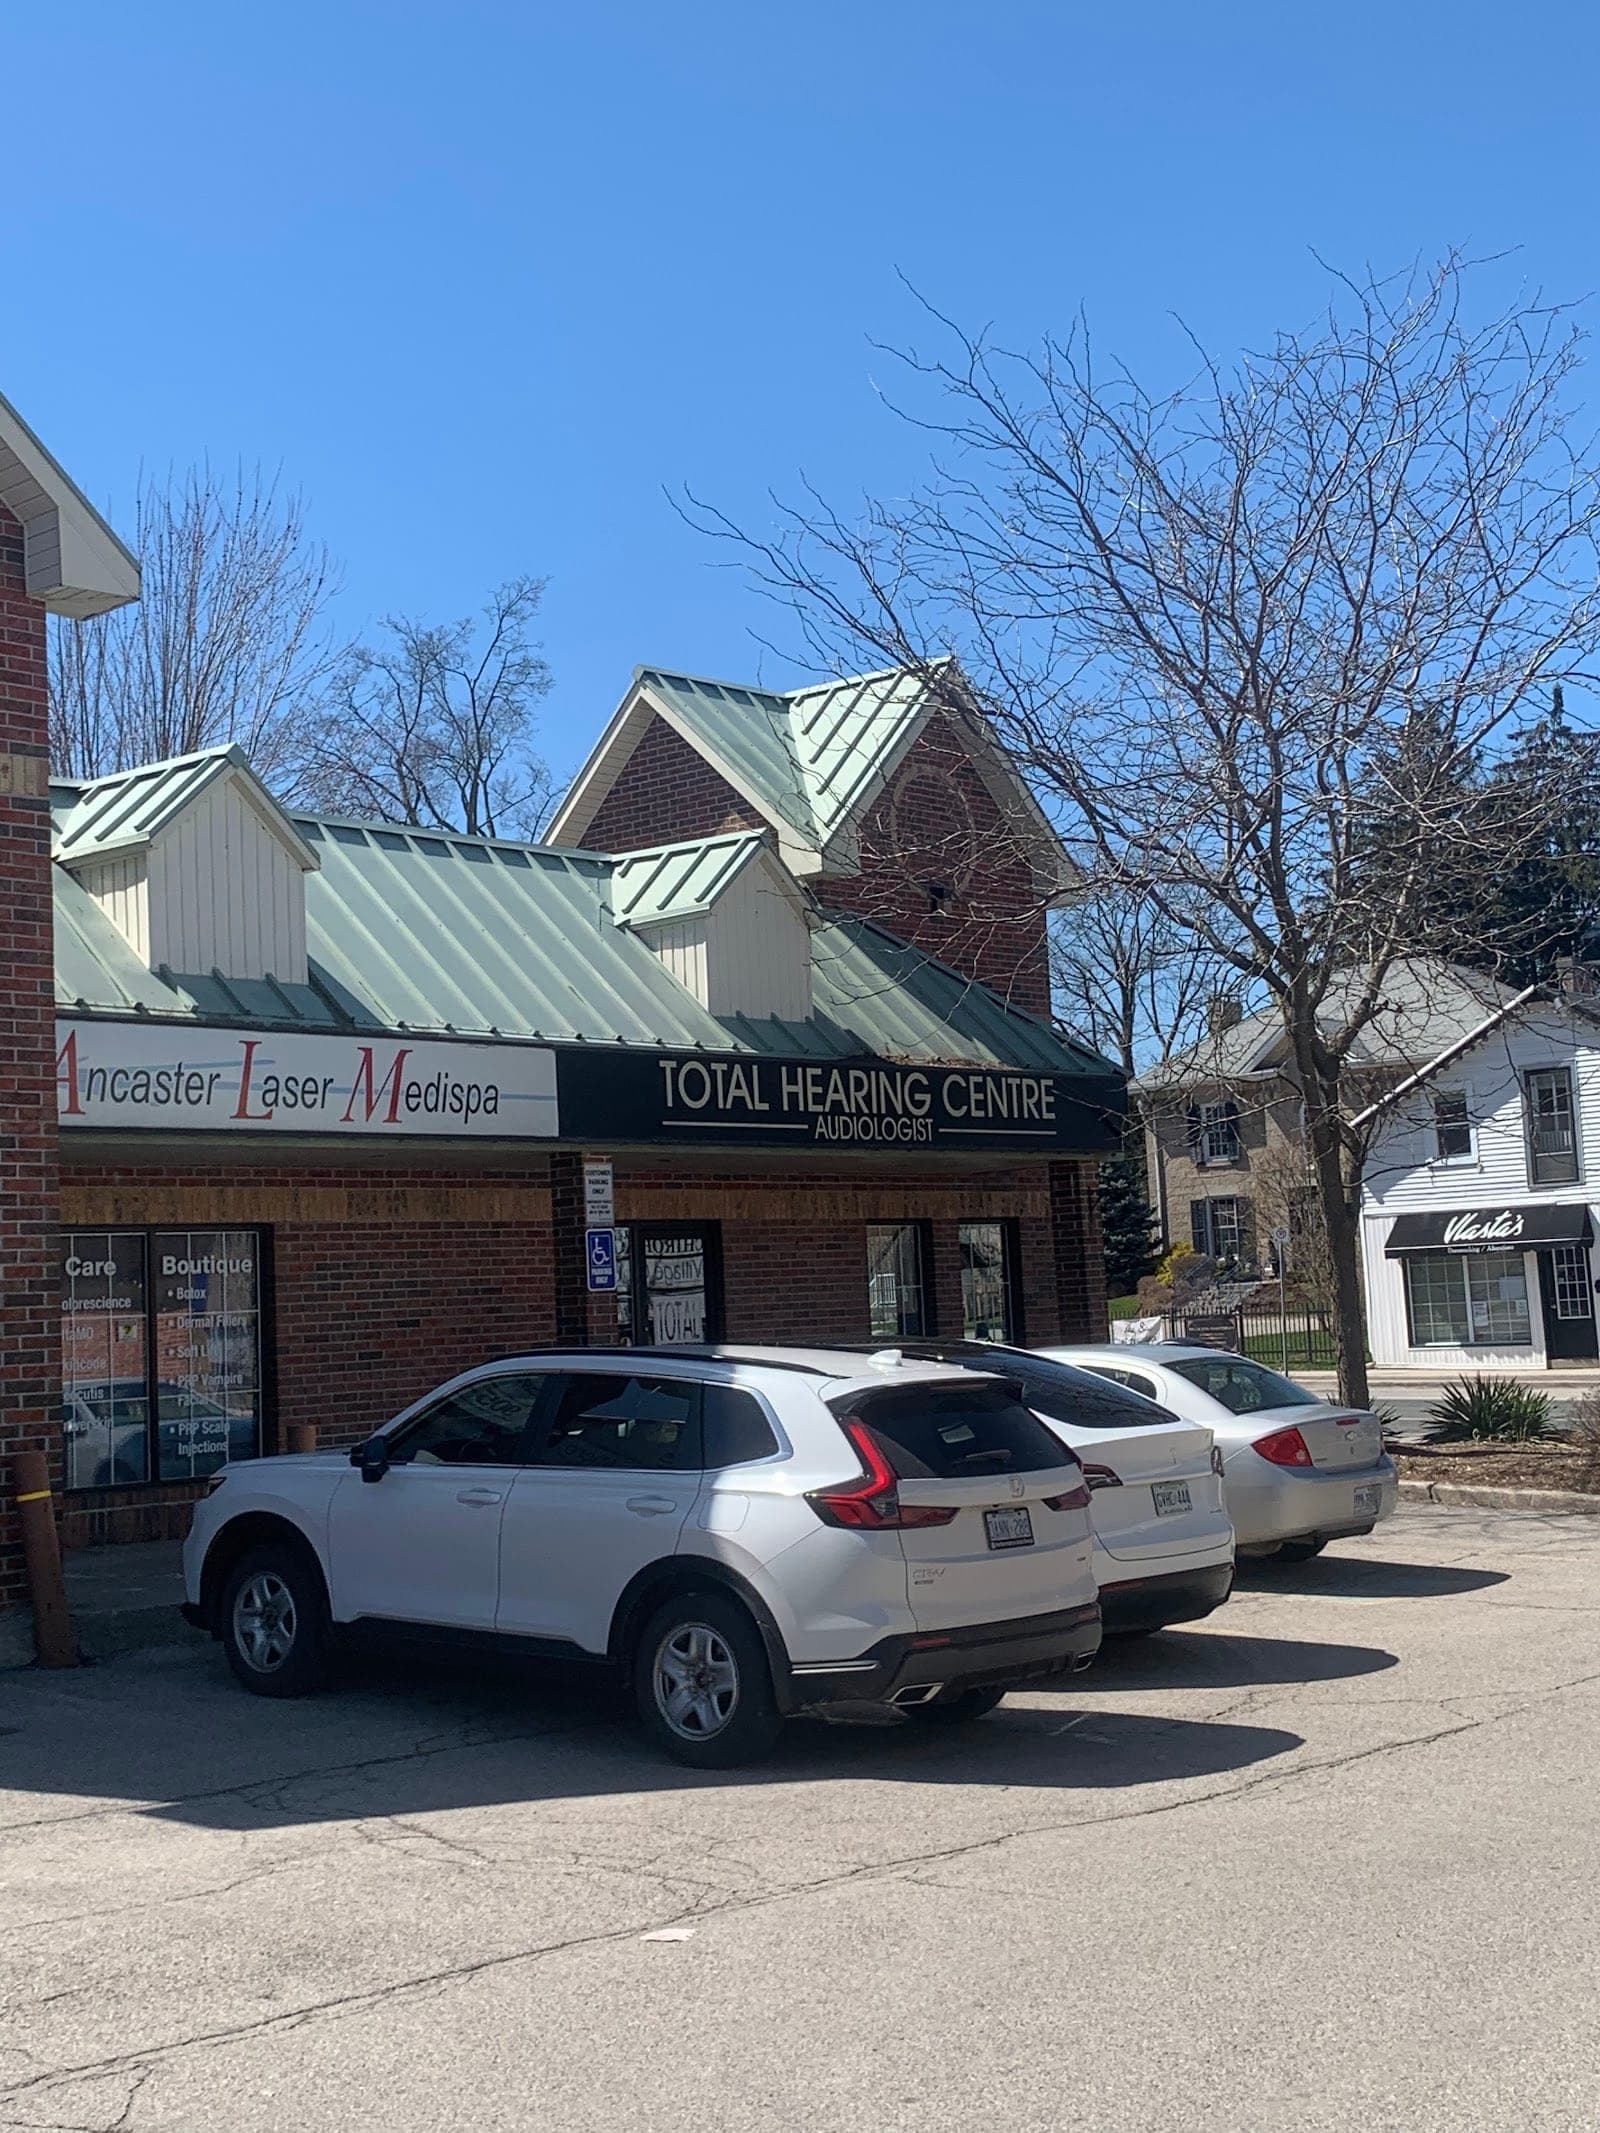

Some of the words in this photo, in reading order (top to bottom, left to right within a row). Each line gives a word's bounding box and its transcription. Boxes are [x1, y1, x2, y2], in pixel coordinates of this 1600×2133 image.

[55, 1029, 221, 1116] Ancaster
[229, 1040, 334, 1121] Laser
[339, 1046, 500, 1124] Medispa
[659, 1060, 770, 1111] TOTAL
[781, 1066, 932, 1117] HEARING
[942, 1073, 1057, 1120] CENTRE
[814, 1114, 934, 1142] AUDIOLOGIST
[1443, 1210, 1525, 1244] Vlasta's
[65, 1256, 117, 1277] Care
[162, 1255, 253, 1277] Boutique
[176, 1287, 207, 1299] Botox
[62, 1296, 131, 1312] olorescience
[62, 1358, 107, 1372] kincode
[178, 1422, 200, 1435] PRP
[202, 1420, 230, 1436] Scalp
[178, 1439, 229, 1457] Injections
